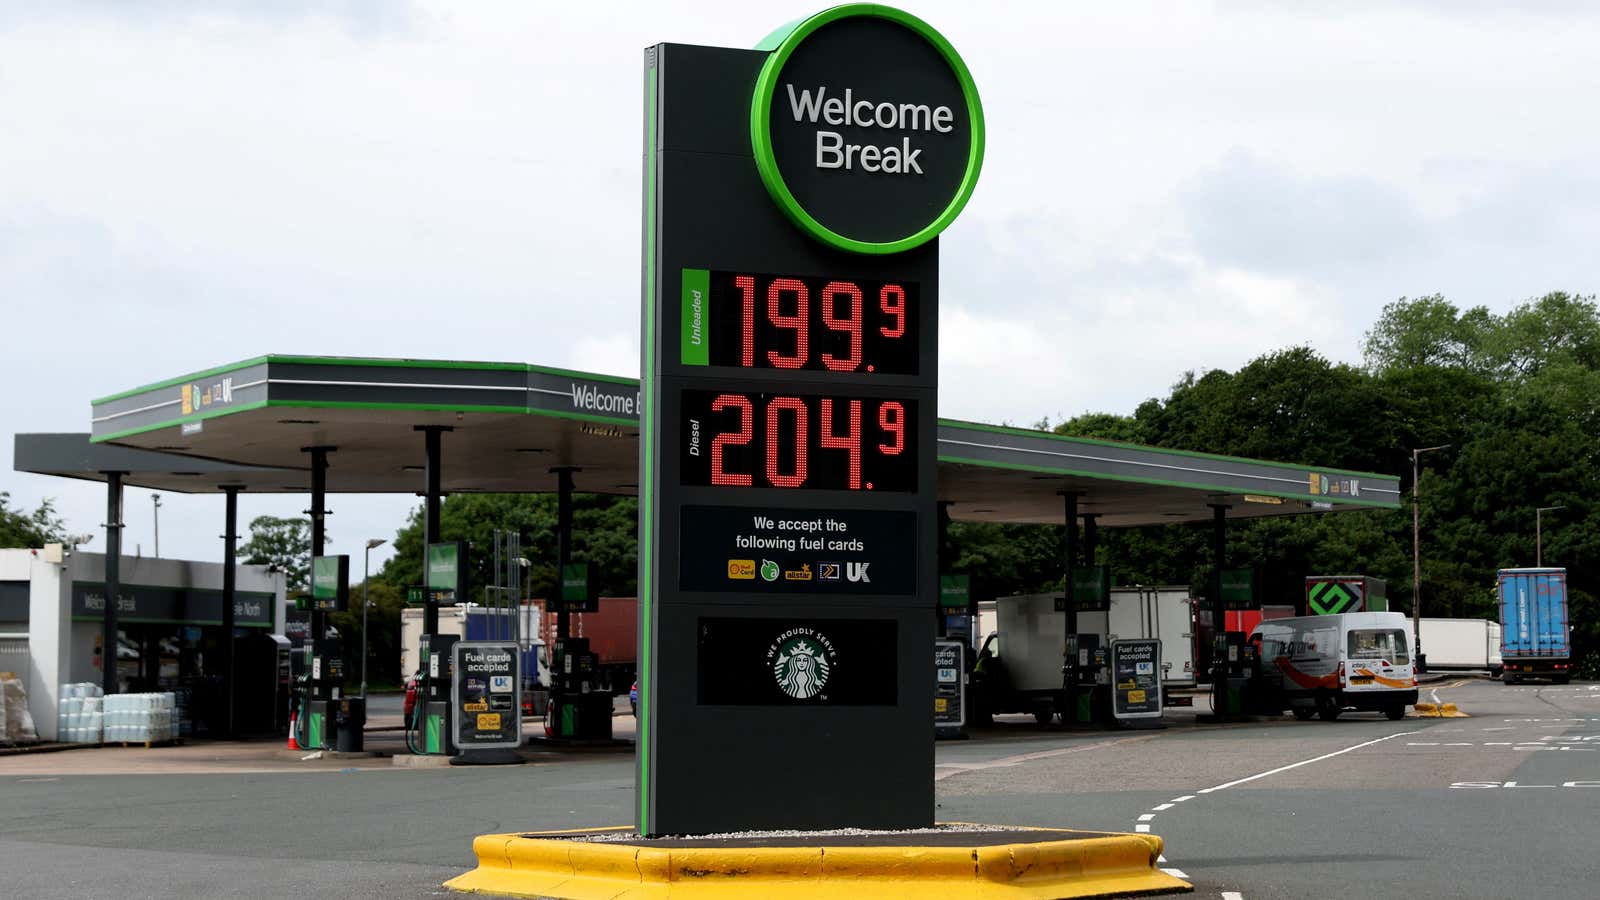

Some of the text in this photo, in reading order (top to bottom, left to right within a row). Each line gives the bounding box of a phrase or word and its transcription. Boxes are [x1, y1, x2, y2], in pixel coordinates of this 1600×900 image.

[786, 83, 954, 133] Welcome
[816, 130, 924, 174] Break
[691, 289, 702, 345] Unleaded
[571, 383, 634, 415] Welcome
[689, 419, 700, 457] Diesel
[753, 516, 847, 533] We accept the
[735, 535, 864, 552] following fuel cards
[846, 561, 871, 583] UK
[767, 627, 836, 658] WE PROUDLY SERVE
[1134, 645, 1153, 653] cards
[465, 652, 511, 662] Fuel cards
[467, 662, 509, 672] accepted
